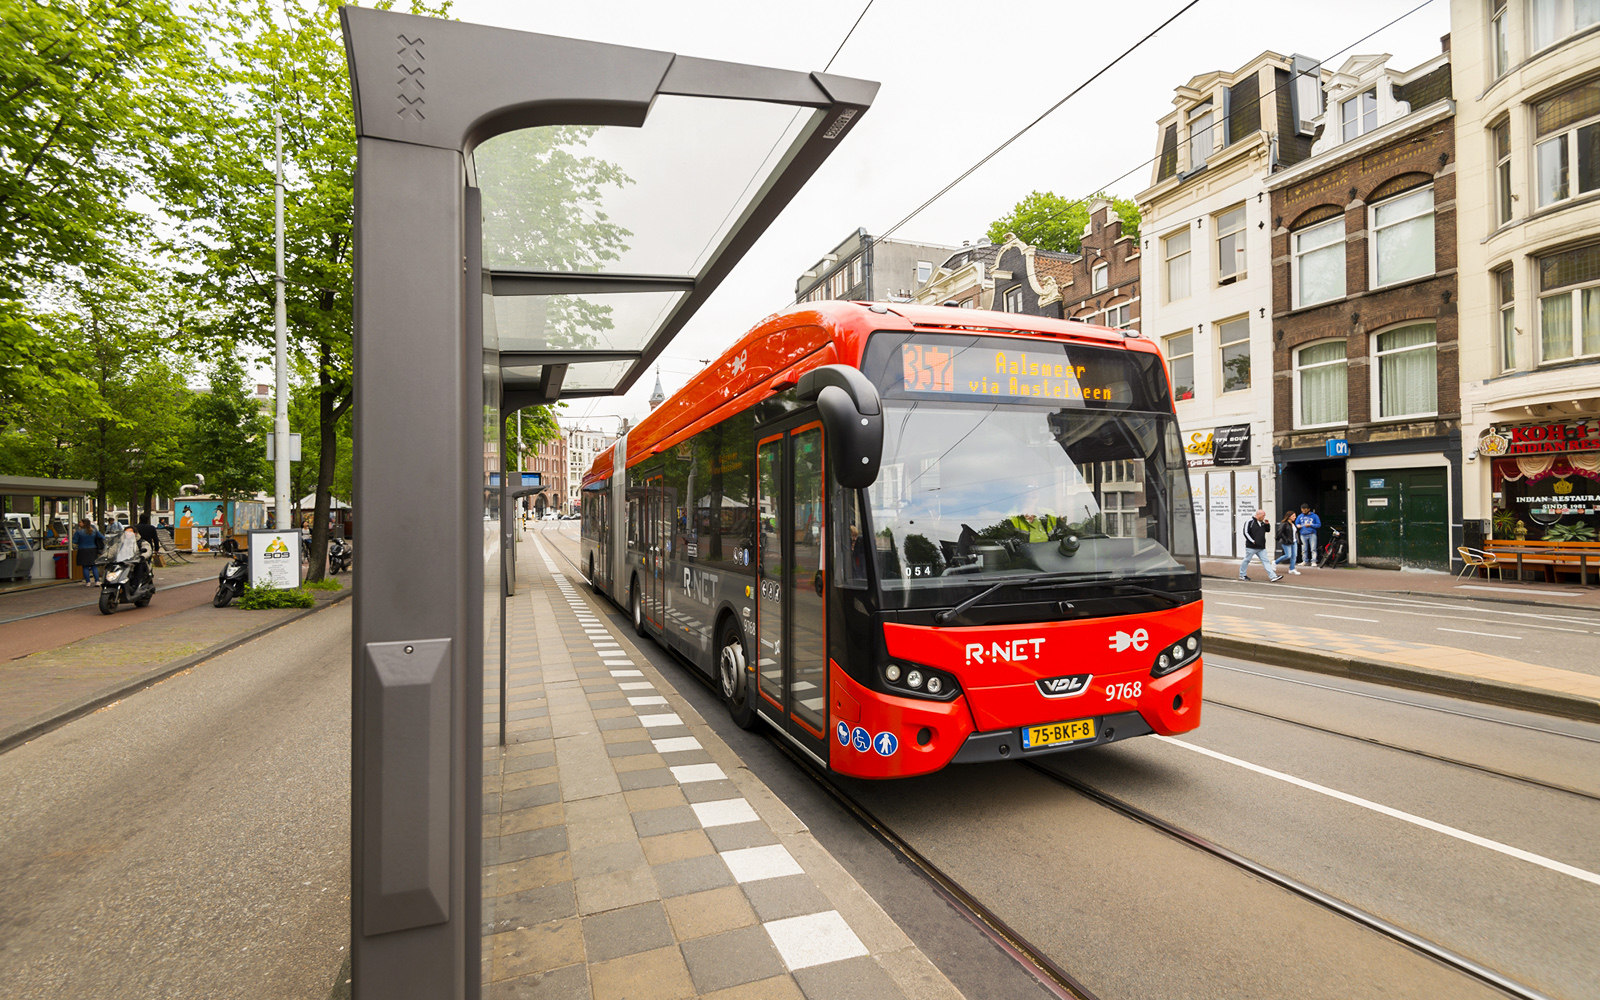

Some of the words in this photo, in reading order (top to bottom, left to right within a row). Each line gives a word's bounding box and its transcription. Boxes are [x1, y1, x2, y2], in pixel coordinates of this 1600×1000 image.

[995, 351, 1086, 379] Aalsmeer
[969, 376, 1000, 394] via
[1009, 376, 1112, 400] Amstelveen
[1510, 420, 1600, 443] KOH-I-
[1510, 440, 1566, 455] INDIAN
[1044, 677, 1082, 692] VDL
[1105, 681, 1142, 702] 9768
[1033, 722, 1090, 744] 75-BKF-8
